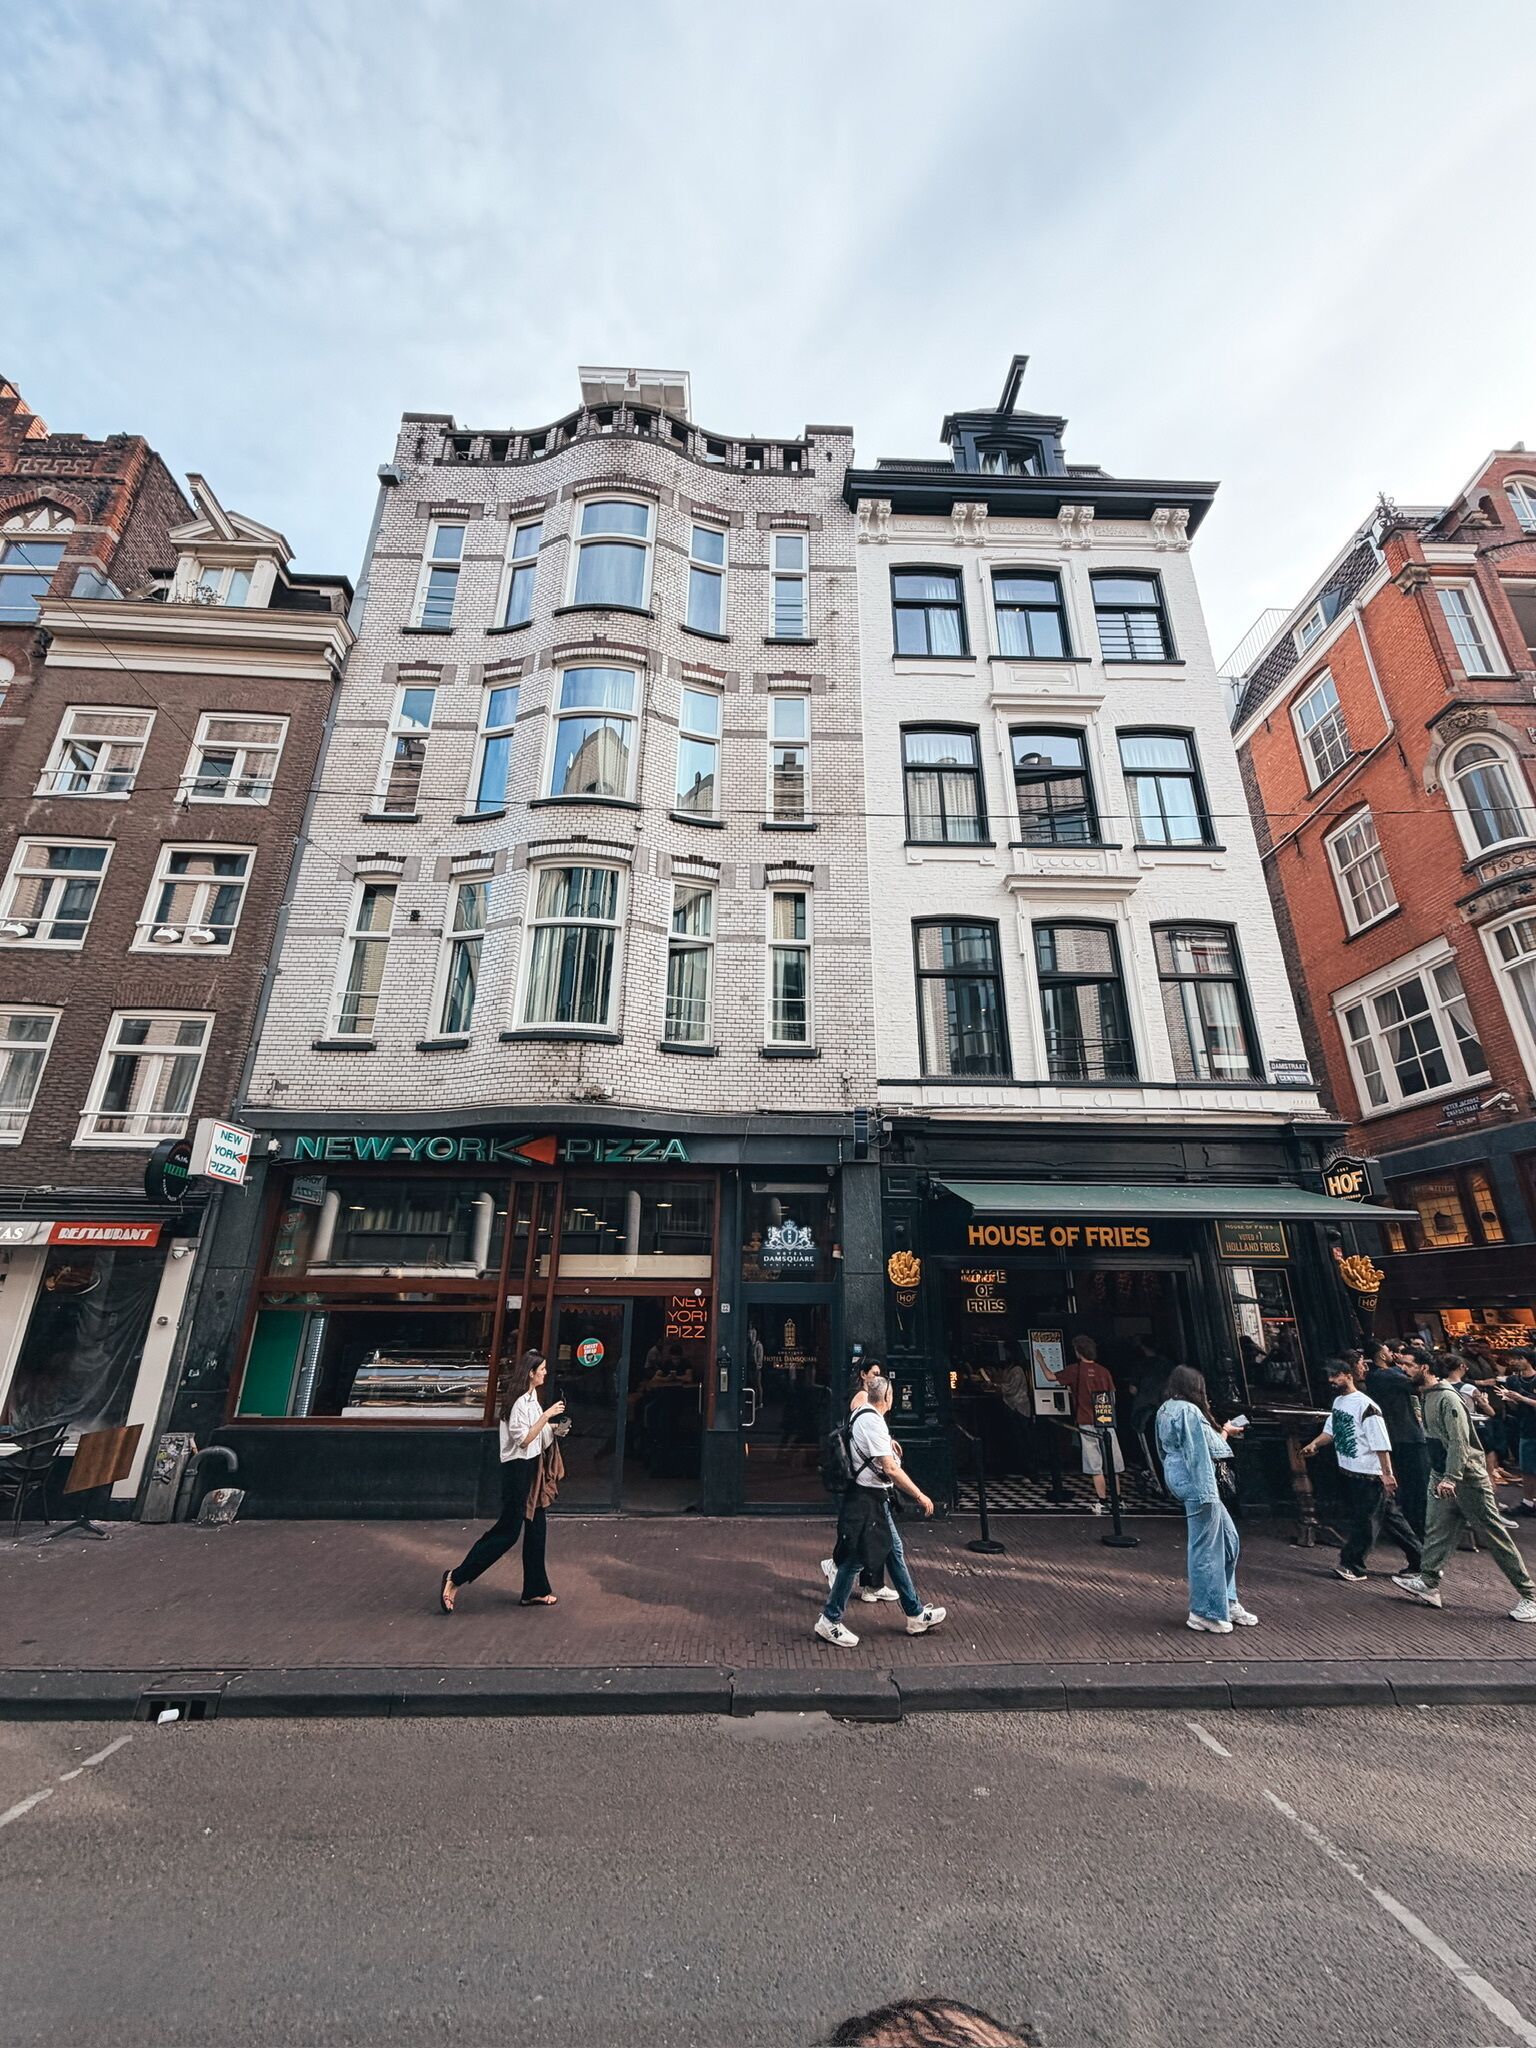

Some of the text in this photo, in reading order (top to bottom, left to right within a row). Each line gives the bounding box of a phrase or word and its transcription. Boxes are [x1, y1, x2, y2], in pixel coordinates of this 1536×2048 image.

[220, 1130, 243, 1146] NEW
[214, 1144, 243, 1164] YORK
[294, 1135, 689, 1166] NEW YORK PIZZA
[210, 1160, 237, 1177] PIZZA
[1327, 1170, 1363, 1196] HOF
[58, 1227, 152, 1241] RESTAURANT
[968, 1225, 1150, 1247] HOUSE OF FRIES
[1226, 1242, 1281, 1252] HOLLAND FRIES
[976, 1284, 994, 1297] OF
[900, 1294, 917, 1303] HOF
[967, 1298, 1006, 1313] FRIES
[667, 1311, 708, 1322] YOR
